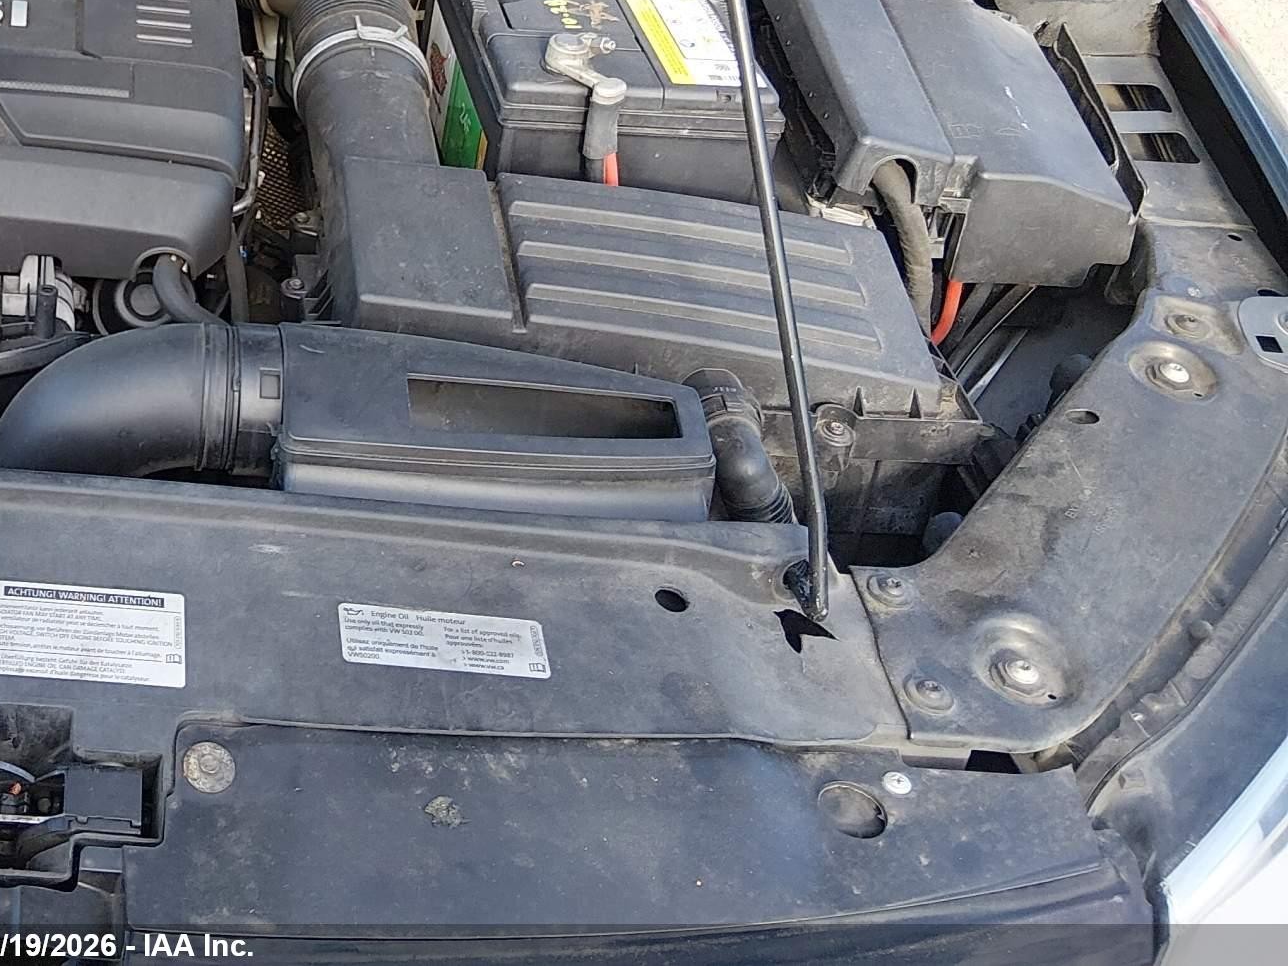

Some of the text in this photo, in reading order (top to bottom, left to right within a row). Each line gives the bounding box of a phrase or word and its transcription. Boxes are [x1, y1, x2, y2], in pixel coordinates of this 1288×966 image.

[7, 587, 162, 606] ACHTUNG! WARNING! ATTENTION!
[370, 611, 397, 620] Engine
[438, 617, 465, 625] moteur
